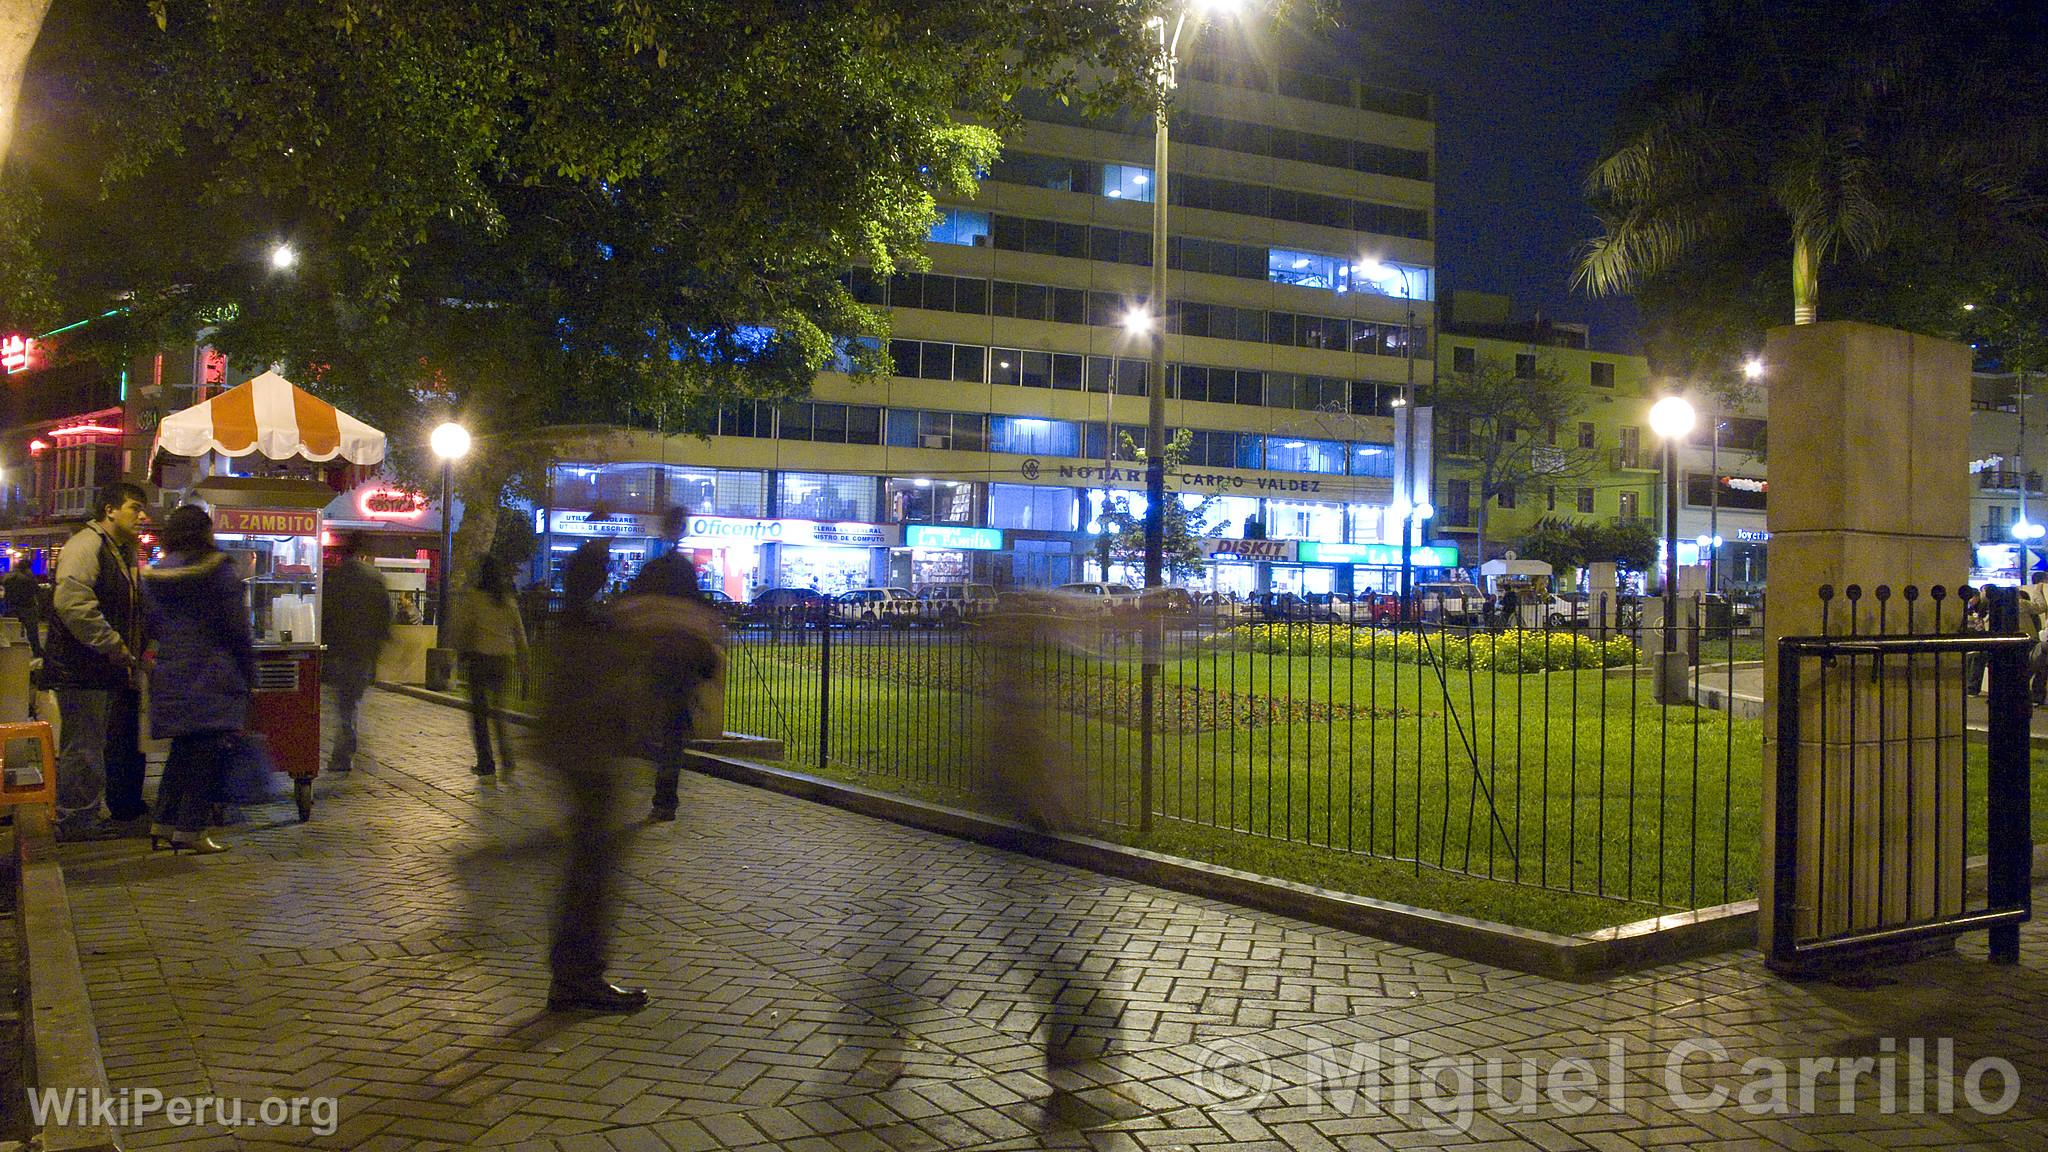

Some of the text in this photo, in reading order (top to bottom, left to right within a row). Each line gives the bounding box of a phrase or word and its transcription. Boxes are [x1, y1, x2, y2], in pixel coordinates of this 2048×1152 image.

[1060, 465, 1165, 483] NOTAR
[1257, 477, 1320, 492] VALDEZ
[219, 514, 315, 531] A. ZAMBITO
[1217, 540, 1285, 555] DISKIT
